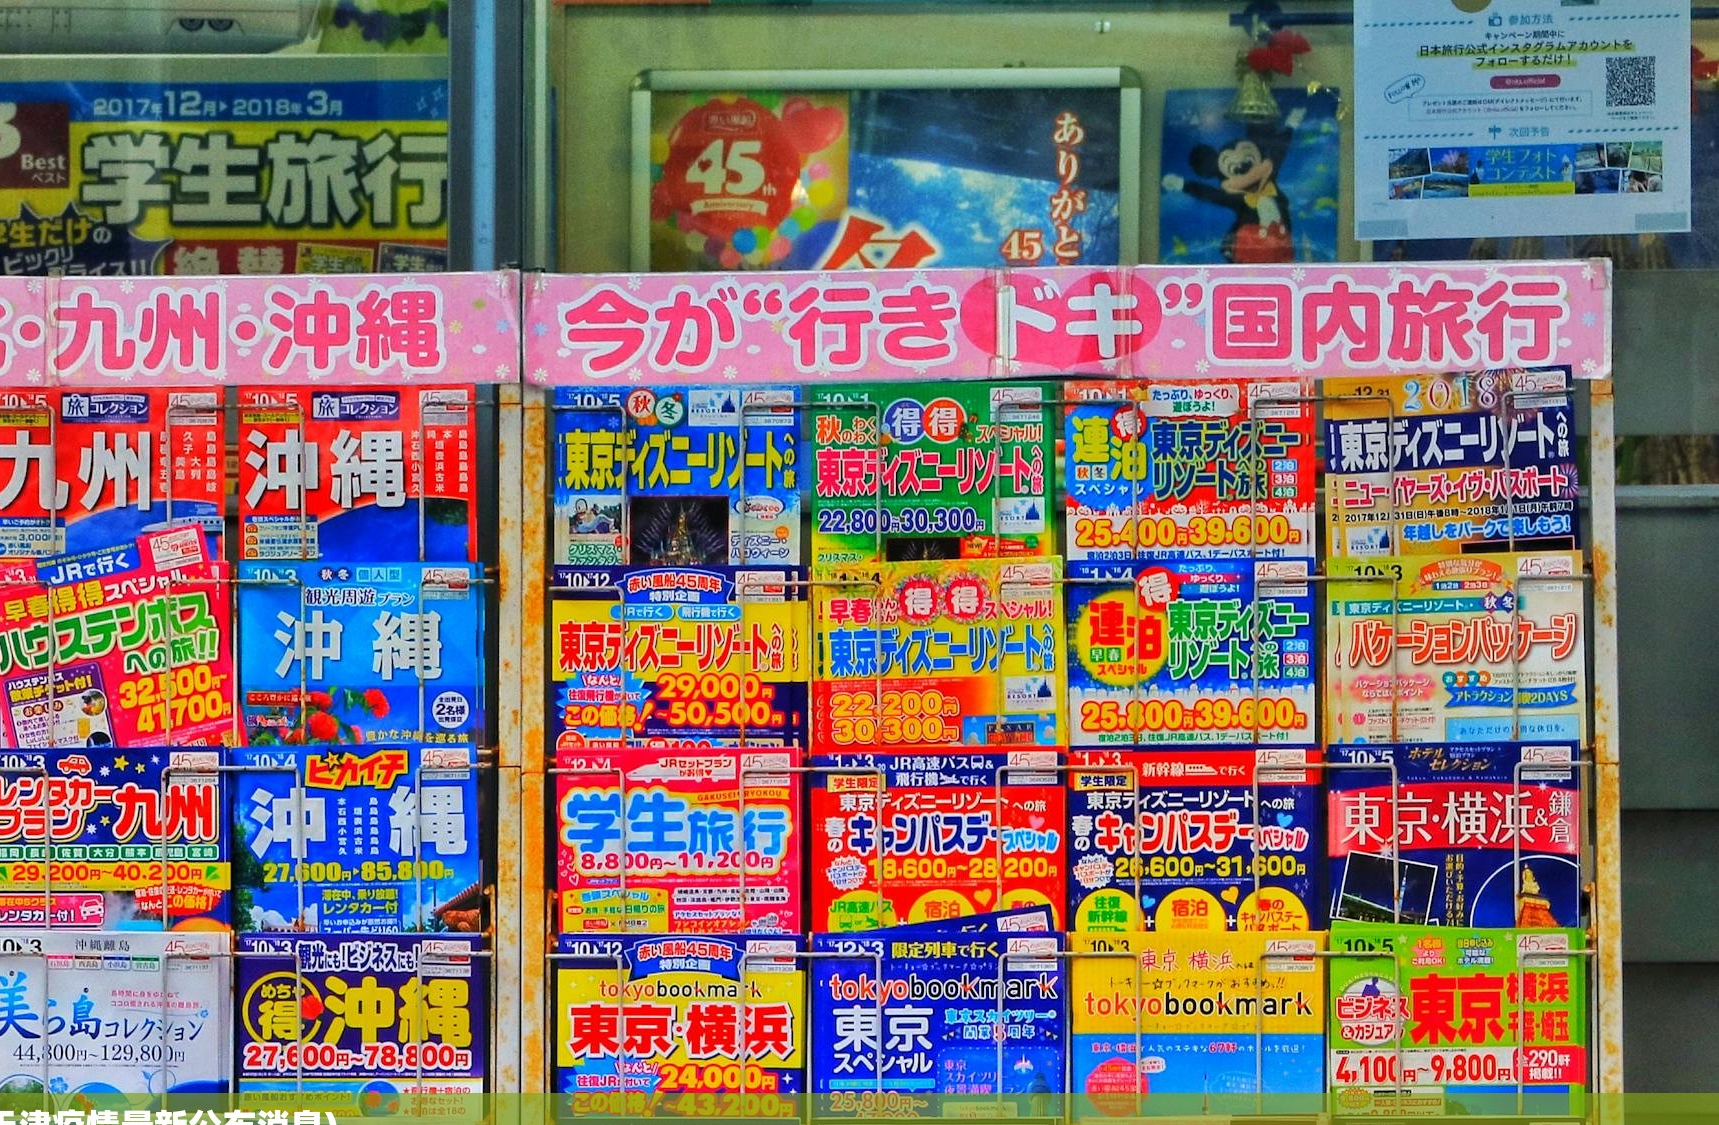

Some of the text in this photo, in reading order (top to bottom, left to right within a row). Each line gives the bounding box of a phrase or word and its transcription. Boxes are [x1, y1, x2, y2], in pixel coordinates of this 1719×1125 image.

[1508, 13, 1553, 25] 参加方法
[1485, 30, 1565, 39] キャンペーン期間中に
[1419, 39, 1633, 56] 日本旅行公式インスタグラムアカウントを
[1508, 127, 1550, 137] 次回予告
[21, 155, 66, 170] Best
[33, 172, 66, 183] ベスト
[81, 132, 449, 226] 学生旅行
[1488, 165, 1558, 181] コンテスト
[1052, 112, 1086, 266] ありがと
[1003, 230, 1042, 260] 45
[1172, 400, 1217, 414] 遊ぼうよ!
[245, 430, 407, 510] 沖縄
[49, 550, 130, 586] JRで行く
[628, 573, 721, 592] 赤い風船45周年
[305, 588, 415, 607] 観光周遊プラン
[648, 590, 700, 603] 特別企画
[274, 611, 443, 681] 沖縄
[436, 702, 466, 716] 2名様
[660, 757, 733, 770] JRセットプラン
[833, 776, 880, 791] 学生限定
[565, 791, 786, 856] 学生旅行
[1171, 899, 1209, 917] 宿泊
[75, 940, 130, 952] 沖縄離島
[891, 943, 999, 959] 限定列車で行く
[324, 976, 473, 1049] 沖縄
[1085, 992, 1313, 1019] tokyobookmark
[1409, 975, 1505, 1046] 東京
[569, 1003, 792, 1059] 東京・横浜
[1528, 1067, 1562, 1081] 掲載!!
